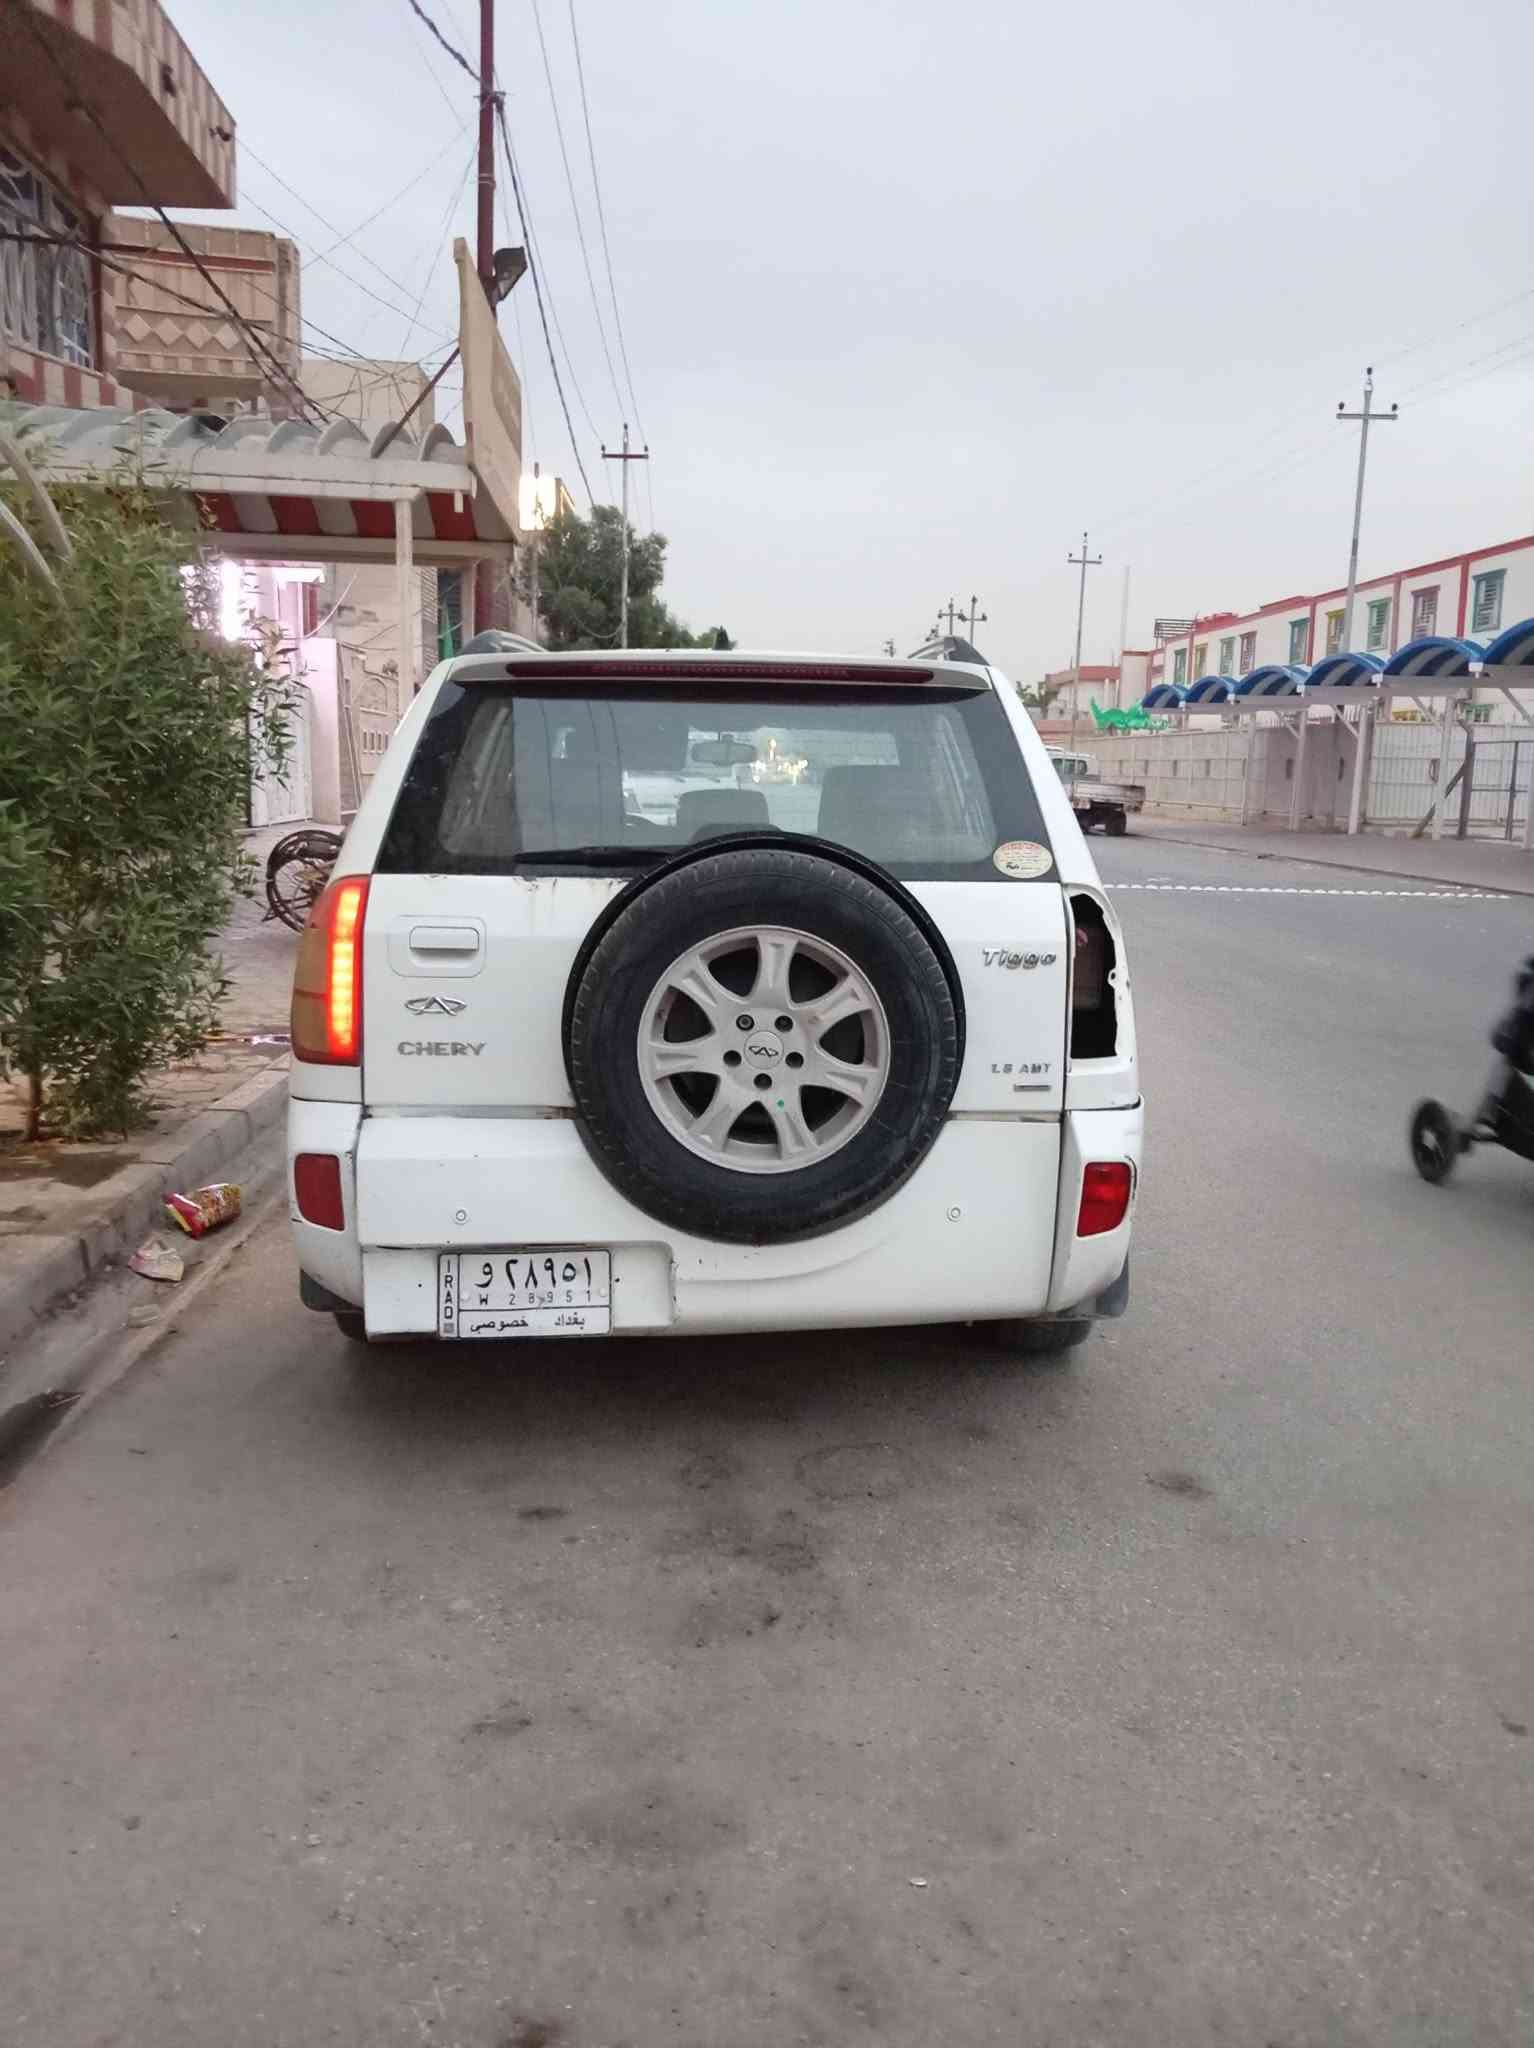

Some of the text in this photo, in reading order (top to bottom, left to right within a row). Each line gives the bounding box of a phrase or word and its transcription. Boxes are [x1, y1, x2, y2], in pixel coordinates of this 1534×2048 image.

[982, 948, 1057, 970] Tiggo
[397, 1041, 487, 1056] CHERY
[470, 1311, 585, 1334] بغداد خصوصي
